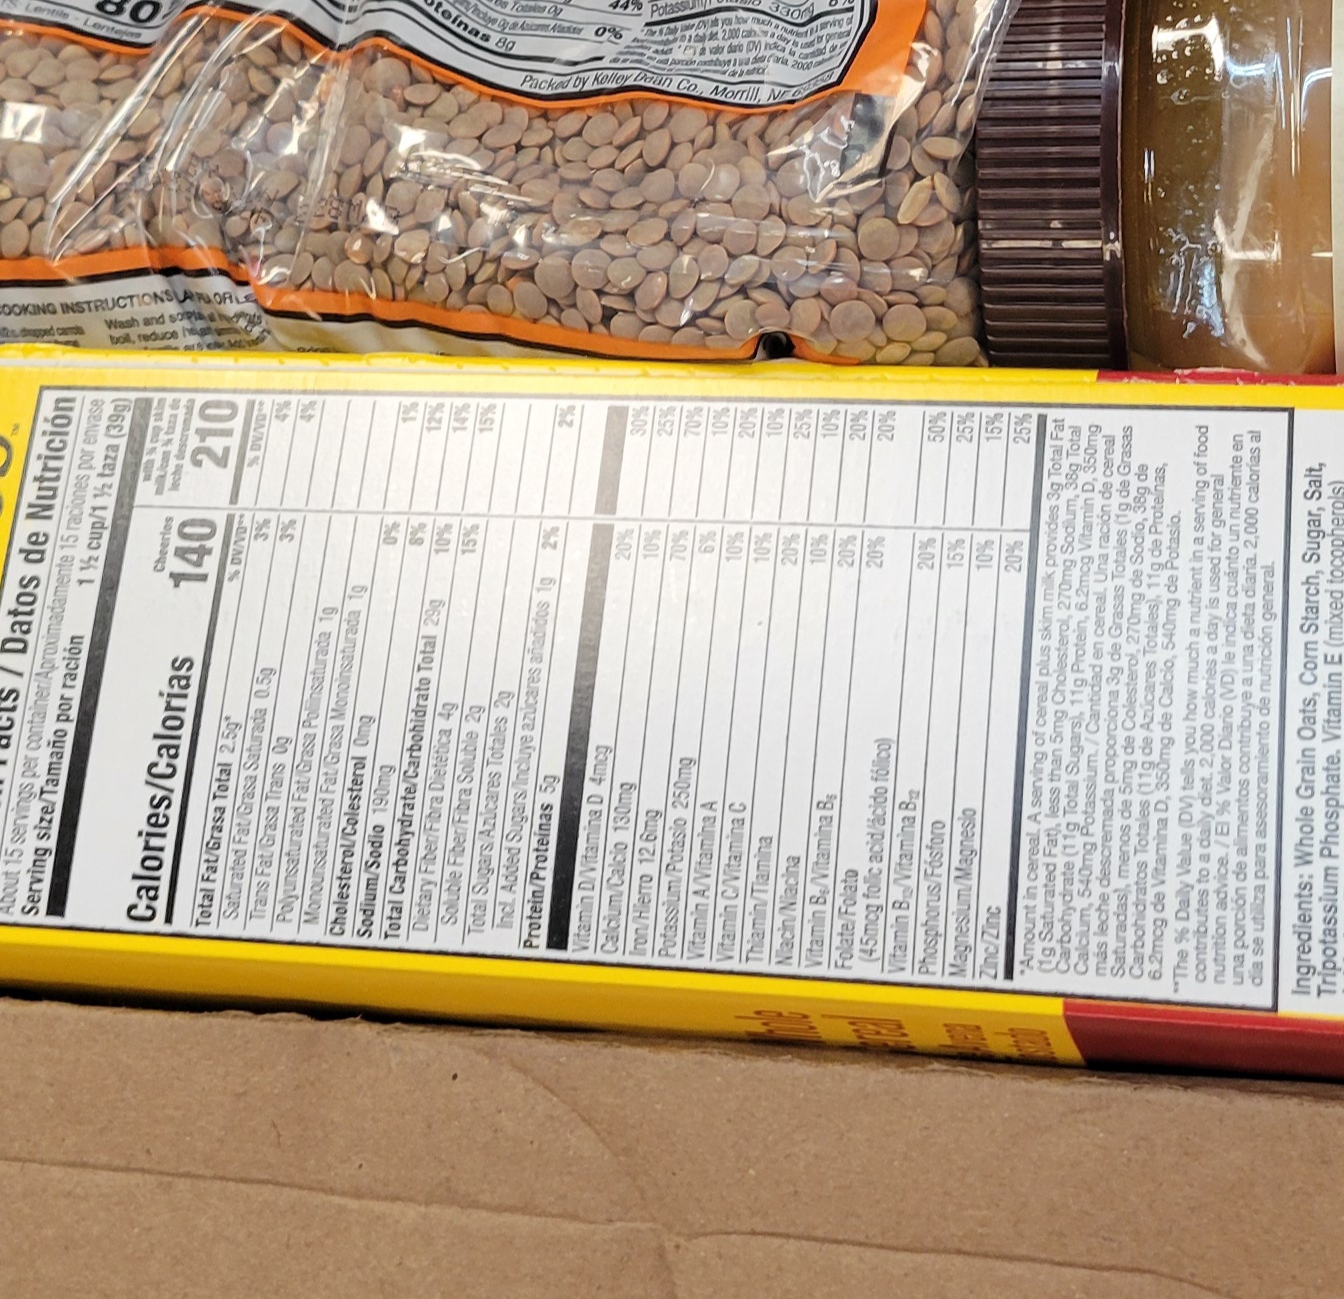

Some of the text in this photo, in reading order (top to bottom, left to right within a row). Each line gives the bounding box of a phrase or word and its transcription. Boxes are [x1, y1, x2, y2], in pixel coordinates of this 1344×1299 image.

[594, 26, 624, 41] 0%
[572, 73, 590, 90] by
[25, 396, 77, 521] Nutrición
[102, 398, 133, 442] (39g)
[96, 445, 120, 479] taza
[15, 532, 48, 565] de
[77, 577, 95, 586] 1
[0, 573, 42, 654] Datos
[126, 400, 239, 923] Calories/Calorías 140 210
[1291, 462, 1330, 997] Ingredients: Whole Grain Oats, Corn Starch, Sugar, Salt,
[22, 635, 85, 916] Serving size/Tamaño por ración
[328, 715, 376, 936] Cholesterol/Colesterol 0mg
[356, 765, 396, 939] Sodium/Sodio 190mg
